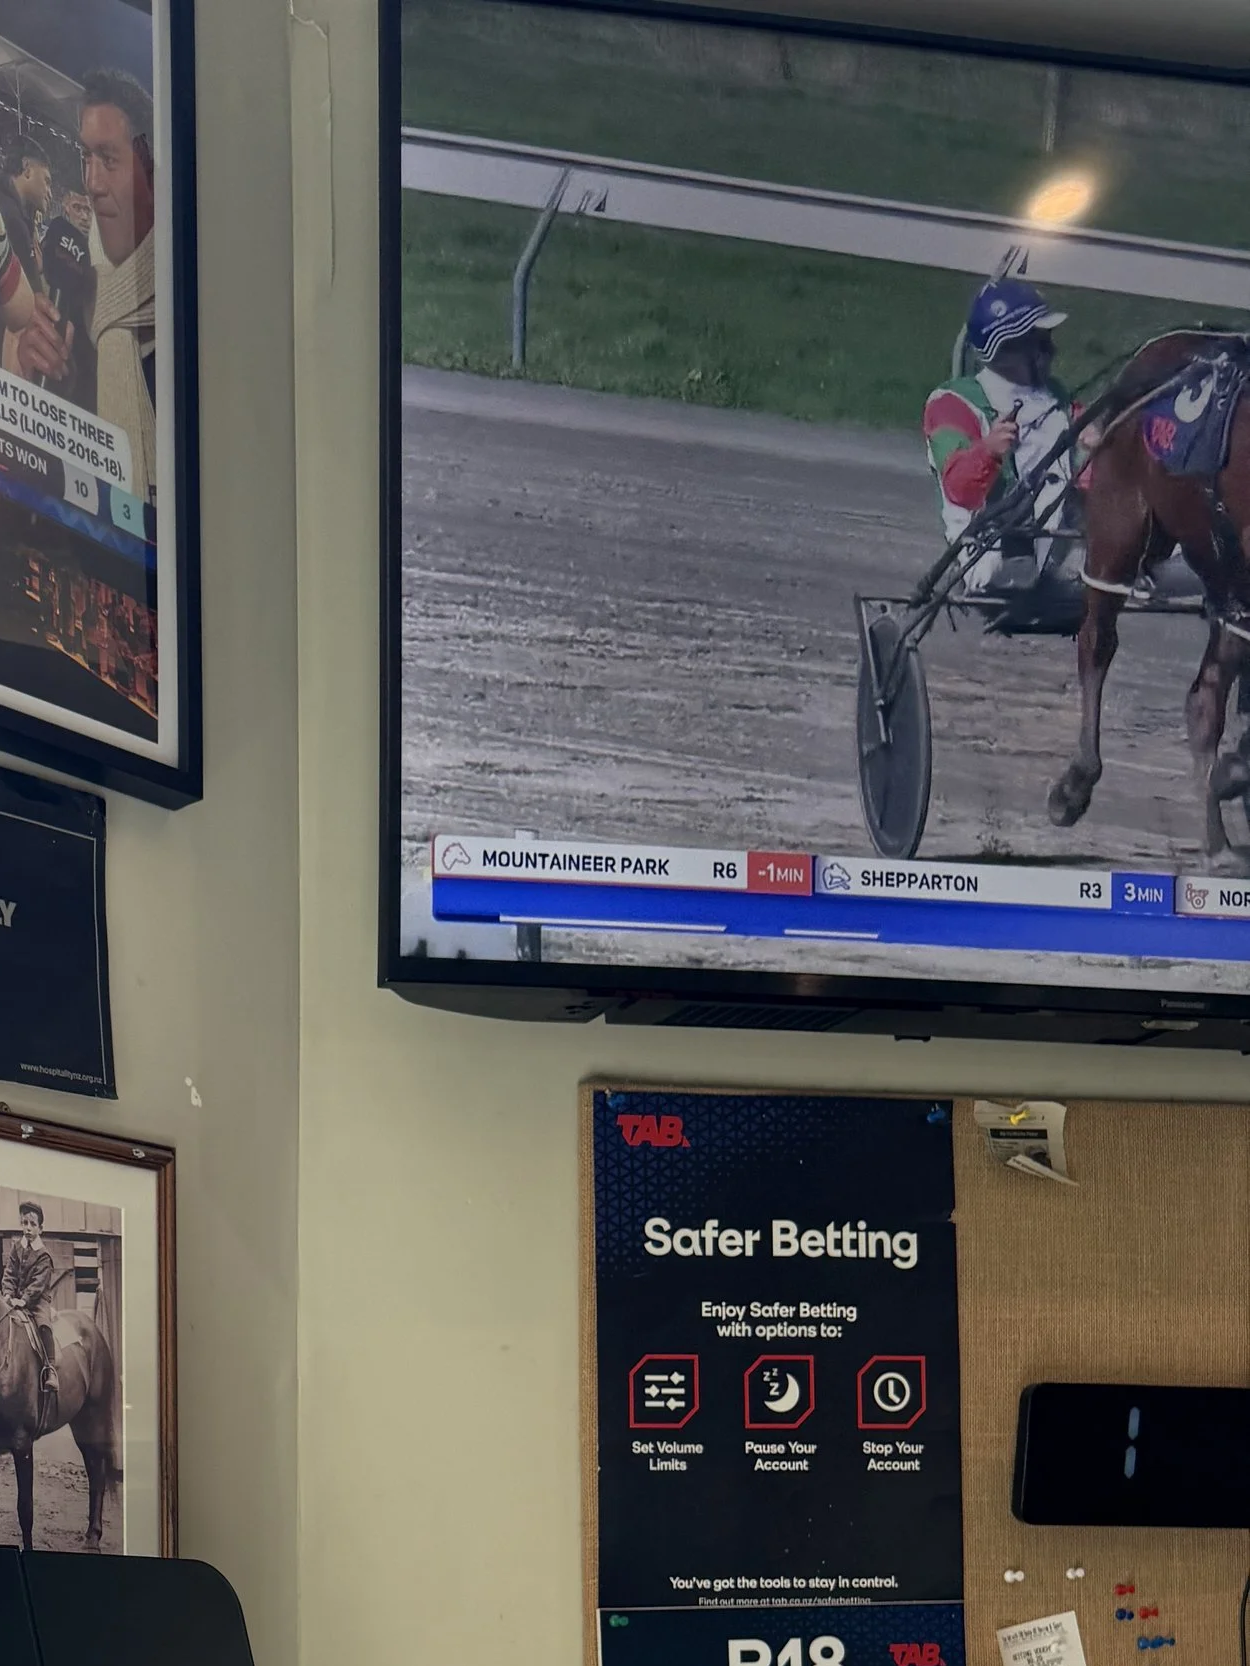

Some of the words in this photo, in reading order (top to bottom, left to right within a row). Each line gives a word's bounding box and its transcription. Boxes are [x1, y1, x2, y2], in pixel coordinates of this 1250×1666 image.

[60, 236, 84, 262] sky
[10, 386, 29, 407] TO
[32, 396, 67, 427] LOSE
[70, 414, 115, 451] THREE
[20, 413, 66, 451] (LIONS
[68, 438, 126, 482] 2016-18).
[16, 444, 47, 475] WON
[75, 479, 88, 498] 10
[123, 504, 131, 520] 3
[482, 850, 617, 873] MOUNTAINEER
[621, 857, 670, 876] PARK
[712, 862, 737, 880] R6
[861, 870, 978, 892] SHEPPARTON
[1079, 882, 1102, 899] R3
[1124, 883, 1163, 903] 3MIN
[644, 1217, 760, 1257] Safer
[772, 1219, 918, 1269] Betting
[701, 1302, 746, 1321] Enjoy
[750, 1303, 796, 1319] Safer
[799, 1304, 858, 1322] Betting
[717, 1322, 751, 1338] with
[755, 1323, 817, 1341] options
[820, 1324, 842, 1338] to:
[632, 1441, 655, 1454] Set
[657, 1441, 703, 1454] Volume
[745, 1442, 785, 1455] Pause
[788, 1442, 817, 1454] Your
[862, 1441, 892, 1456] Stop
[896, 1442, 924, 1454] Your
[649, 1458, 687, 1471] Limits
[754, 1458, 808, 1471] Account
[867, 1458, 920, 1471] Account
[669, 1576, 711, 1591] You've
[713, 1577, 735, 1591] got
[737, 1576, 757, 1589] the
[759, 1576, 790, 1589] tools
[793, 1577, 806, 1588] to
[809, 1577, 836, 1590] stay
[838, 1576, 849, 1588] in
[852, 1576, 899, 1588] control.
